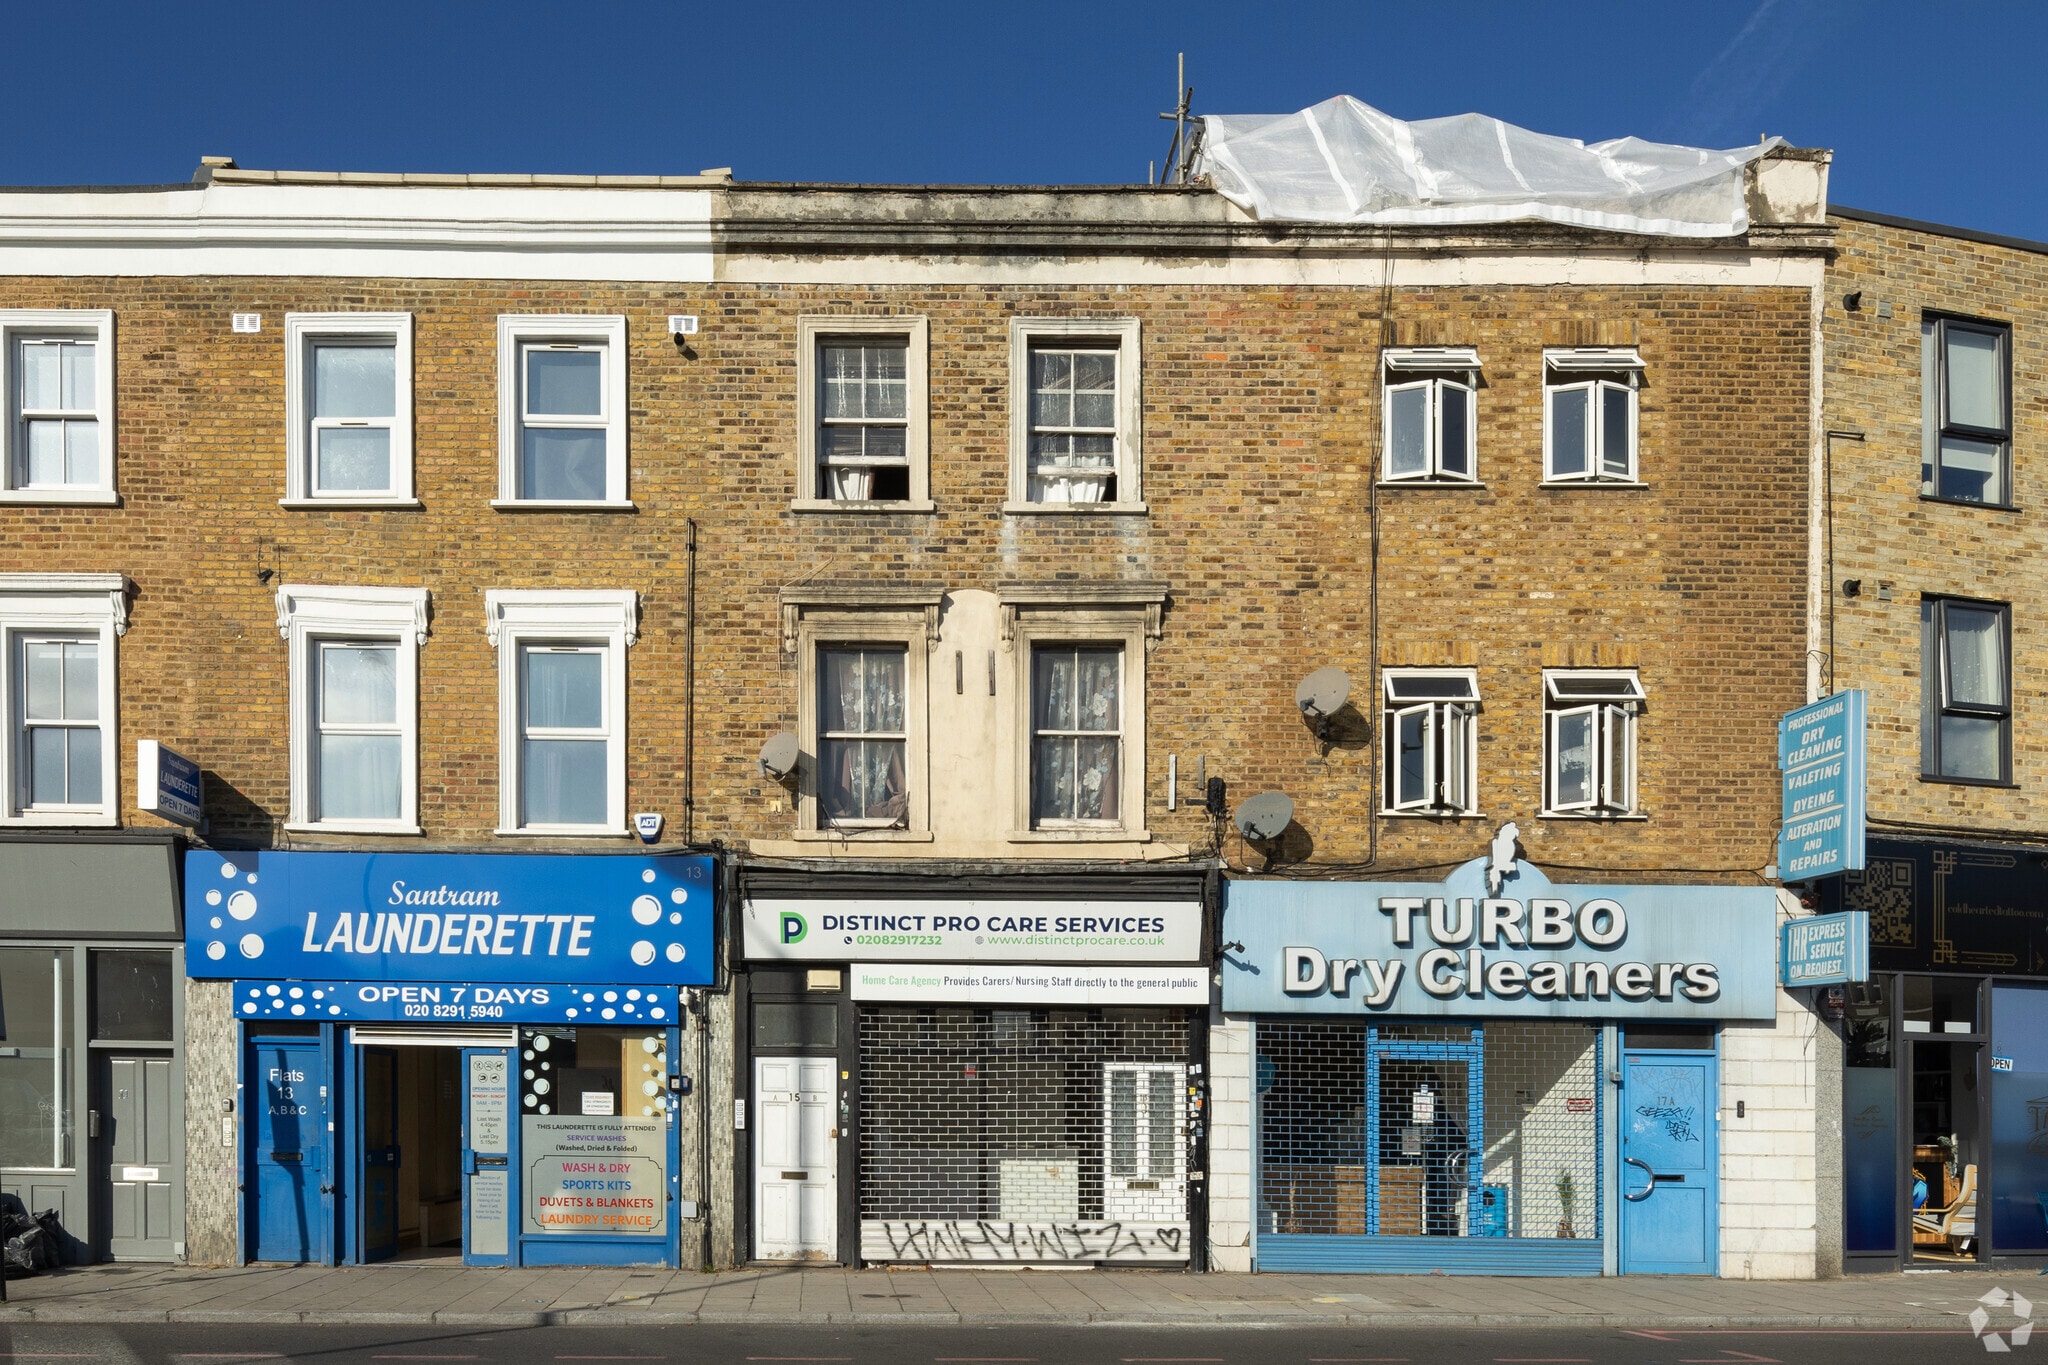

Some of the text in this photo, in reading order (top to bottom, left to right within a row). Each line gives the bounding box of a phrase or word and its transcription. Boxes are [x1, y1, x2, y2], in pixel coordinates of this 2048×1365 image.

[1788, 701, 1844, 732] PROFESSIONAL
[1801, 726, 1825, 745] DRY
[1787, 735, 1842, 766] CLEANING
[160, 770, 198, 798] LAUNDERETTE
[1788, 762, 1841, 790] VALETING
[160, 794, 200, 819] OPEN 7 DAYS
[1793, 789, 1835, 813] DYEING
[641, 818, 656, 827] ADT
[1786, 814, 1842, 841] ALTERATION
[1803, 838, 1822, 852] AND
[1789, 849, 1838, 873] REPAIRS
[686, 867, 702, 879] 13
[388, 880, 501, 907] Santram
[822, 915, 1165, 933] DISTINCT PRO CARE SERVICES
[1378, 896, 1628, 951] TURBO
[1808, 921, 1846, 942] EXPRESS
[302, 911, 596, 957] LAUNDERETTE
[856, 935, 942, 945] 02082917232
[987, 934, 1165, 947] www.distinctprocare.co.uk
[1810, 940, 1845, 960] SERVICE
[1790, 959, 1842, 978] ON REQUEST
[862, 975, 886, 985] Home
[888, 975, 908, 986] Care
[911, 976, 941, 988] Agency
[944, 976, 980, 986] Provides
[1015, 976, 1049, 988] Nursing
[1051, 976, 1072, 987] Staff
[1074, 977, 1106, 988] directly
[1109, 978, 1118, 987] to
[1120, 978, 1134, 988] the
[1136, 978, 1170, 989] general
[1171, 978, 1198, 989] public
[1282, 946, 1721, 1010] Dry Cleaners
[358, 986, 550, 1004] OPEN 7 DAYS
[404, 1005, 503, 1018] 020 8291 5940
[269, 1068, 305, 1082] Flats
[277, 1087, 294, 1100] 13
[789, 1093, 800, 1102] 15
[281, 1106, 288, 1115] B
[289, 1106, 297, 1115] &
[298, 1105, 307, 1116] C
[556, 1144, 586, 1152] (Washed,
[562, 1163, 631, 1173] WASH & DRY
[562, 1180, 632, 1191] SPORTS KITS
[540, 1197, 654, 1208] DUVETS & BLANKETS
[541, 1214, 652, 1226] LAUNDRY SERVICE
